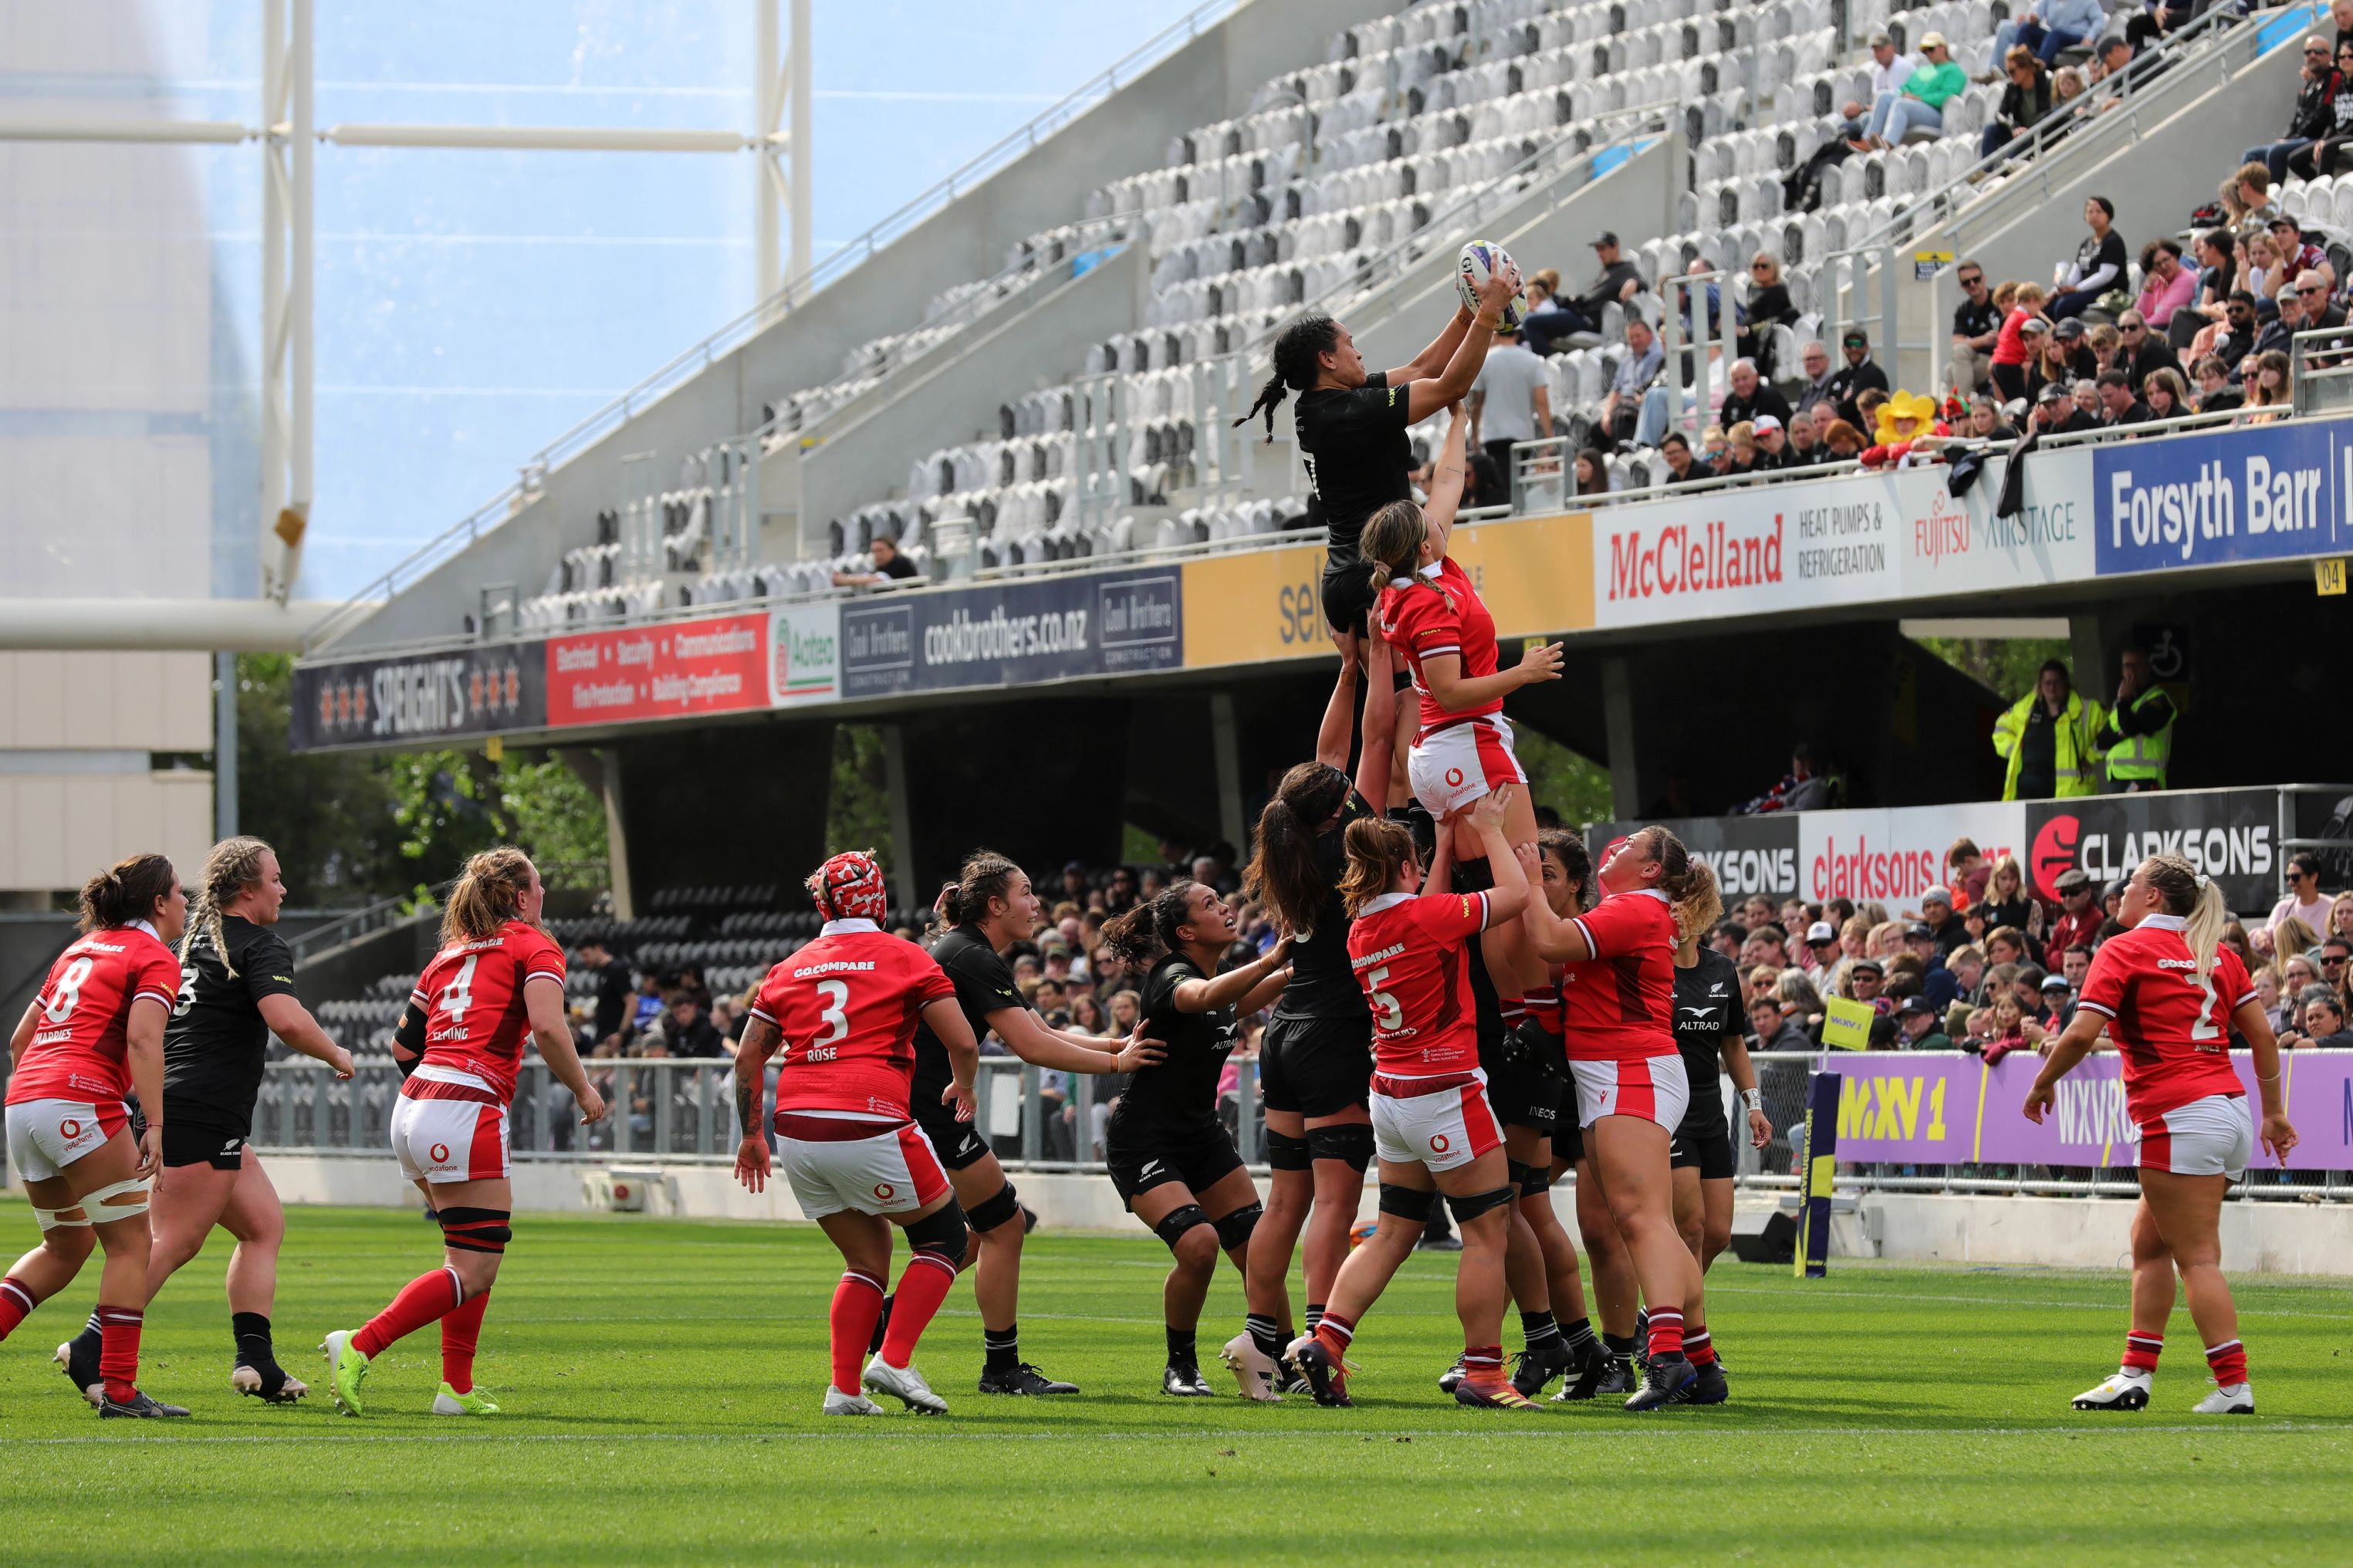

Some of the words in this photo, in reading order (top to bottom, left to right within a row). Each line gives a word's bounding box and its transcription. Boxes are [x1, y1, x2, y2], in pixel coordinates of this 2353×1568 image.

[1799, 508, 1828, 539] HEAT
[1831, 503, 1869, 536] PUMPS
[1870, 502, 1883, 531] &
[2111, 460, 2235, 560] Forsyth
[2247, 455, 2321, 534] Barr
[1915, 513, 1971, 568] FUJITSU
[1985, 502, 2076, 550] AIRSTAGE
[1608, 514, 1784, 601] McClelland
[1798, 542, 1885, 580] REFRIGERATION
[2323, 563, 2340, 590] 04
[1130, 594, 1171, 630] Brothers
[1279, 553, 1333, 644] sel
[924, 605, 1088, 666] cookbrothers.co.nz
[372, 658, 465, 735] SPEIGHT'S
[1449, 782, 1476, 799] vodafone
[1813, 834, 2012, 901] clarksons
[793, 961, 875, 978] GO.COMPARE
[1351, 942, 1405, 969] GO.COMPARE
[46, 956, 93, 1023] 8
[439, 954, 478, 1023] 4
[1366, 966, 1402, 1030] 5
[2184, 973, 2219, 1041] 2
[813, 979, 849, 1049] 3
[1679, 1021, 1719, 1030] ALTRAD
[34, 1028, 73, 1045] HARRIES
[806, 1046, 837, 1063] ROSE
[1529, 1105, 1556, 1120] INEOS
[2056, 1078, 2135, 1145] WXVRU
[63, 1131, 93, 1152] vodafone
[1433, 1149, 1462, 1163] vodafone
[1800, 1108, 1814, 1208] WXVRUGBY.COM
[428, 1164, 458, 1172] vodafone
[877, 1197, 907, 1208] vodafone
